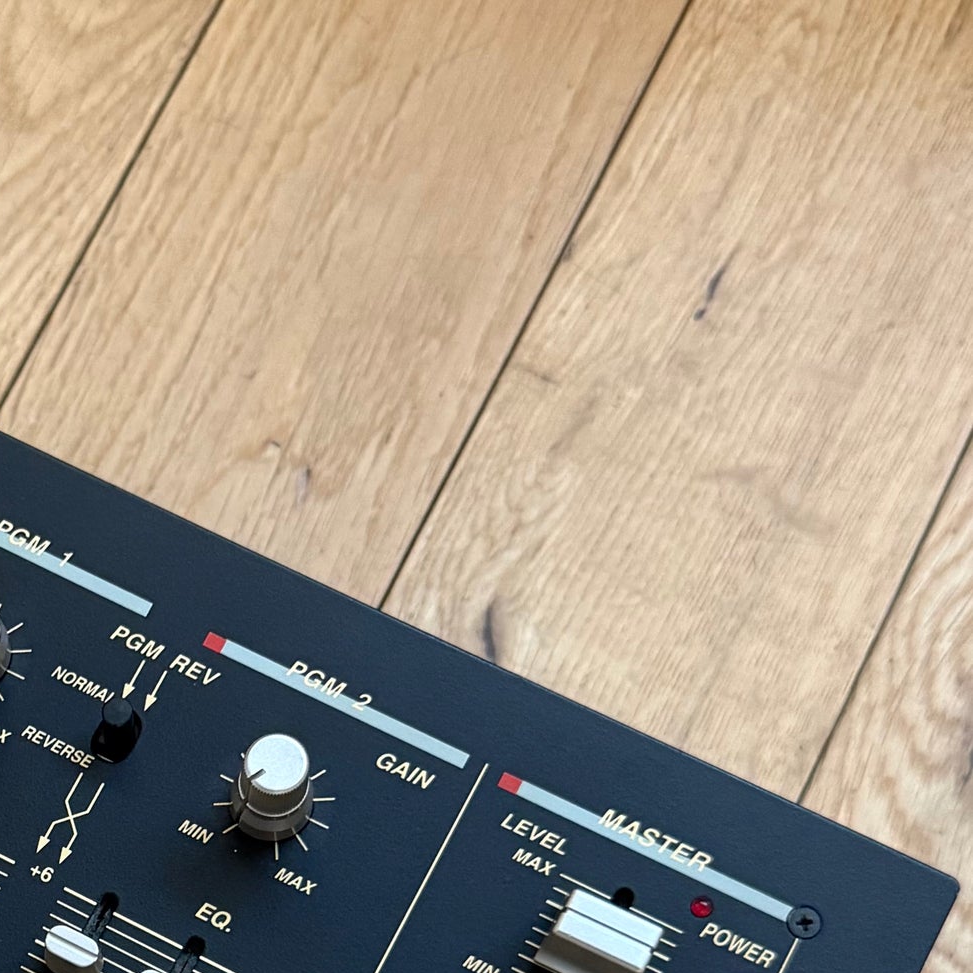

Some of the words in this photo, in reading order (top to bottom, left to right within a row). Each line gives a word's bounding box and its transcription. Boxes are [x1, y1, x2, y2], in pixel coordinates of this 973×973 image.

[61, 551, 74, 568] 1
[110, 625, 165, 661] PGM
[169, 653, 221, 686] REV
[285, 661, 346, 699] PGM
[352, 694, 373, 711] 2
[21, 725, 95, 768] REVERSE
[375, 753, 436, 790] GAIN
[178, 819, 214, 845] MIN
[500, 813, 568, 856] LEVEL
[598, 808, 714, 873] MASTER
[28, 864, 54, 884] +6
[512, 848, 556, 876] MAX
[274, 866, 317, 896] MAX
[194, 902, 232, 932] EQ.
[700, 922, 777, 968] POWER
